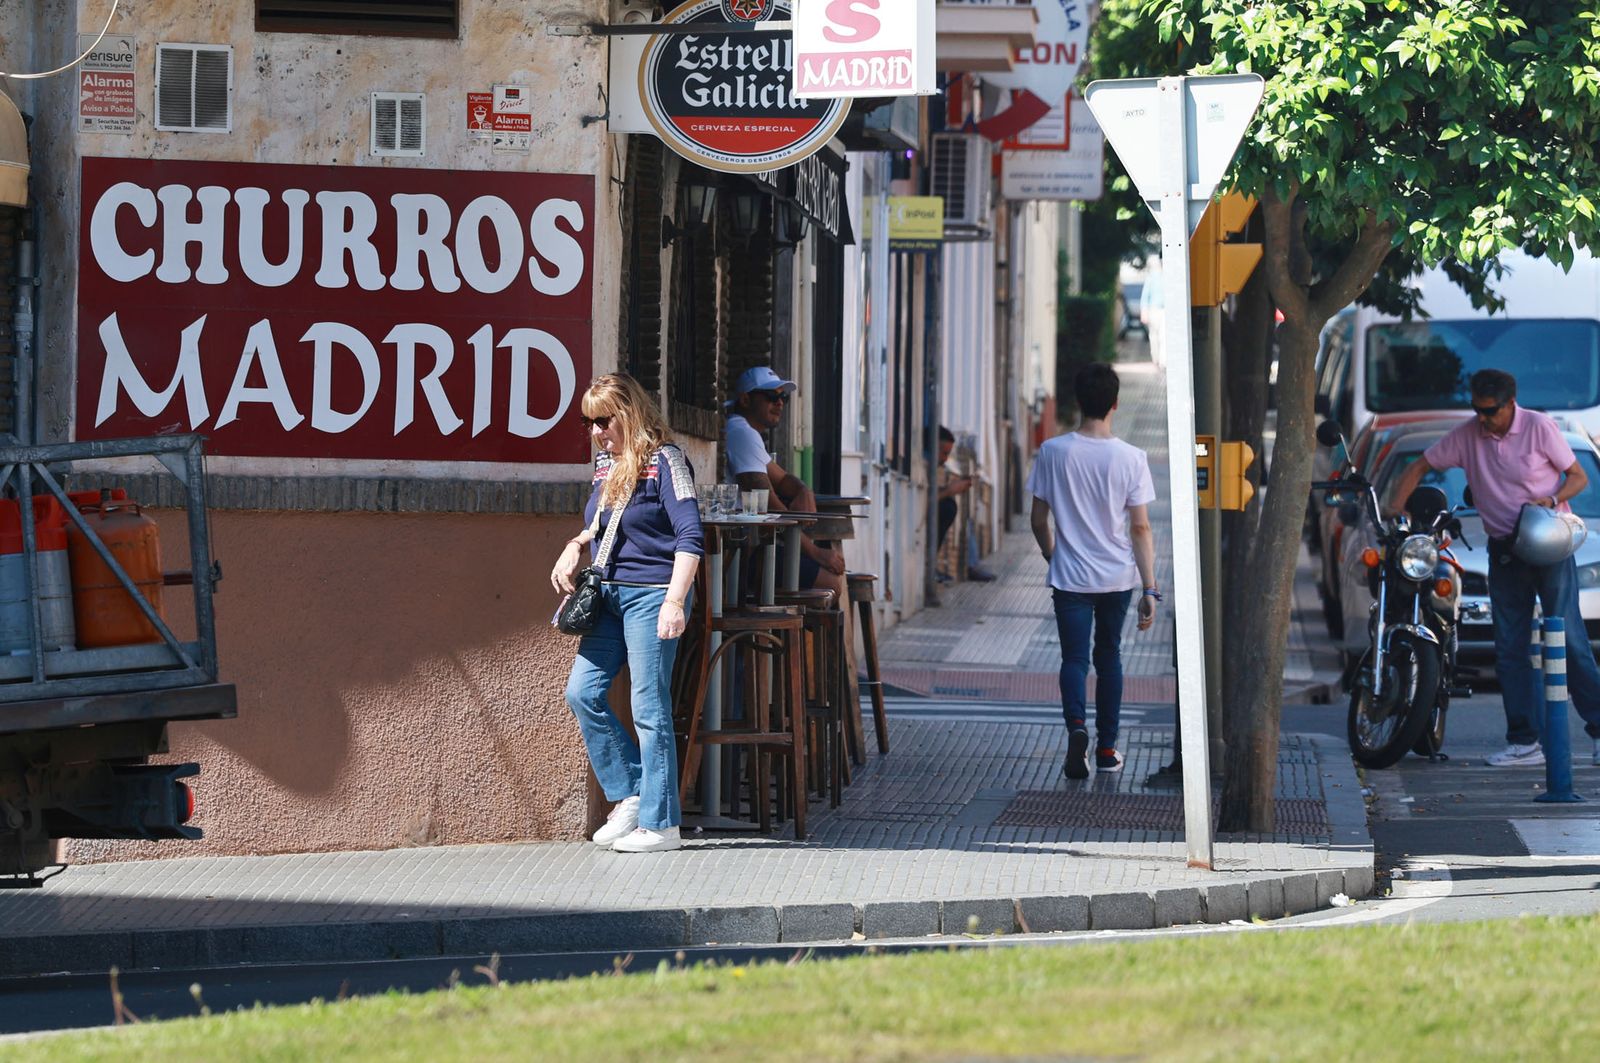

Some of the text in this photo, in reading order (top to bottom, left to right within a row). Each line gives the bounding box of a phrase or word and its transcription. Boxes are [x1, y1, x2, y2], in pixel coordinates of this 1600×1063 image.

[675, 35, 793, 72] Estrell
[1014, 42, 1077, 64] LON
[83, 74, 134, 88] Alarma
[803, 56, 912, 88] MADRID
[682, 73, 810, 110] Galicia
[83, 104, 102, 112] Aviso
[495, 115, 529, 125] Alarma
[690, 124, 796, 133] CERVEZA ESPECIAL
[696, 149, 745, 163] CERVECEROS
[775, 150, 792, 159] 1906
[90, 182, 585, 296] CHURROS
[95, 311, 577, 439] MADRID
